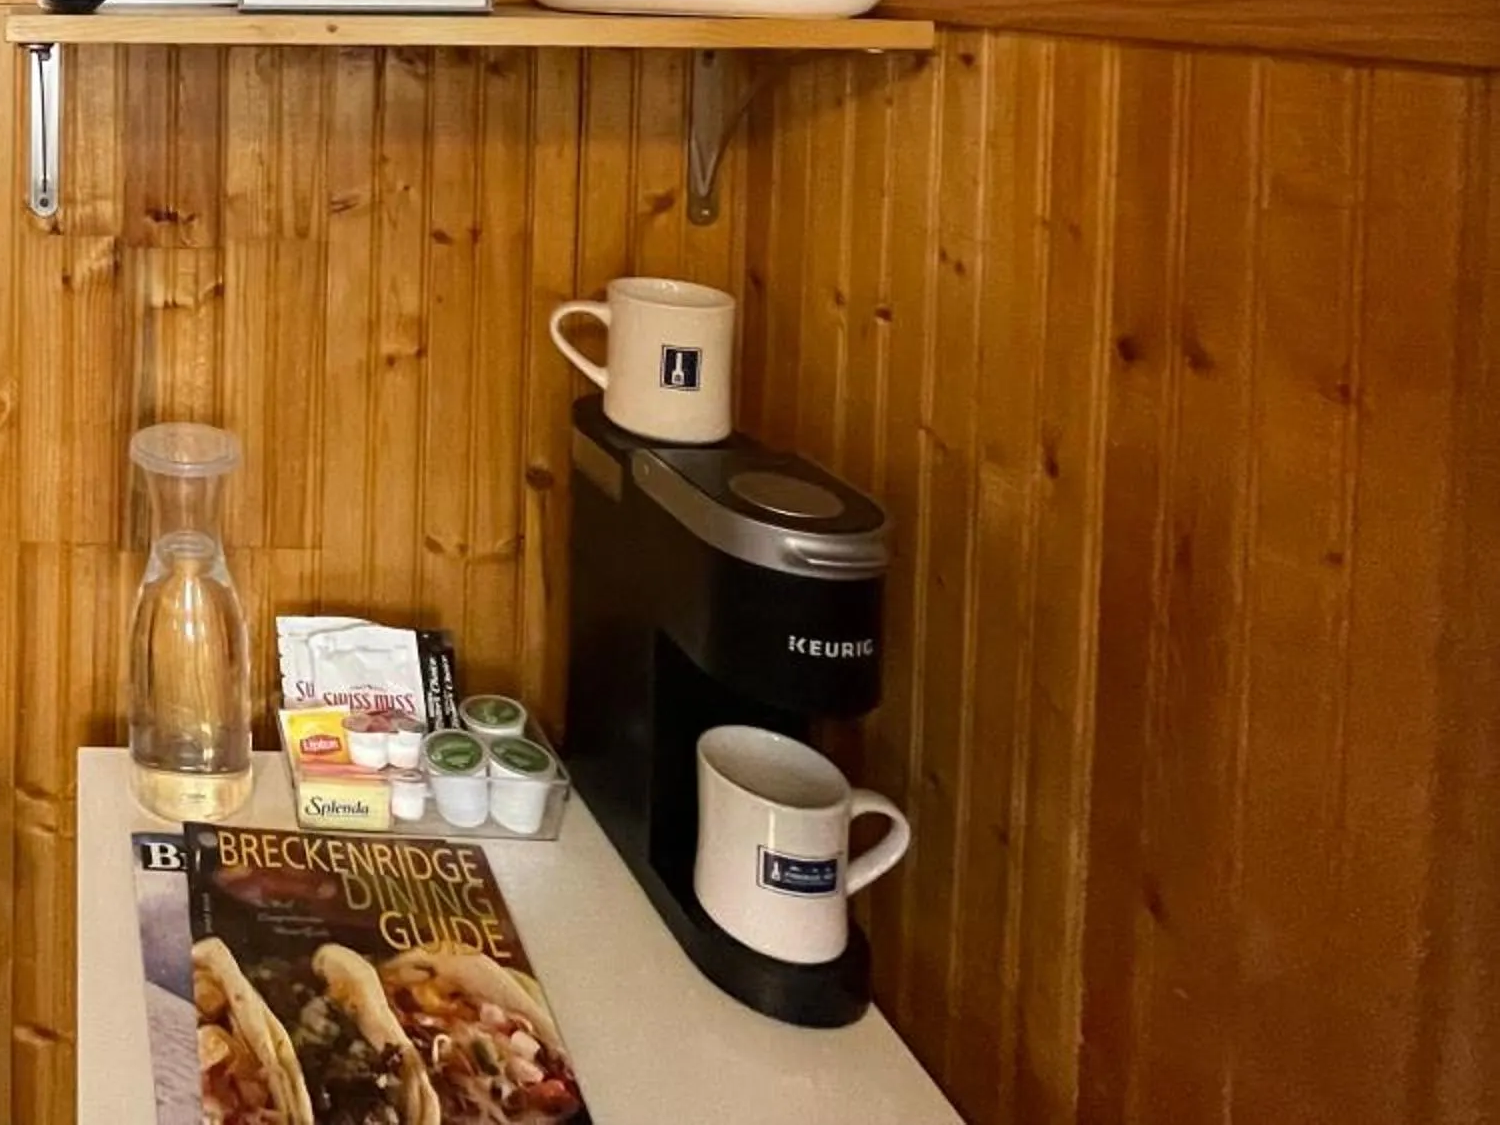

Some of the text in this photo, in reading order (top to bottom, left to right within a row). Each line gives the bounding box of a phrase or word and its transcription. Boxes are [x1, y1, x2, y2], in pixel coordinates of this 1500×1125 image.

[788, 635, 873, 658] KEURIG
[304, 795, 369, 818] Splenda
[218, 832, 484, 885] BRECKENRIDGE
[343, 874, 494, 921] DINING
[379, 911, 511, 959] GUIDE
